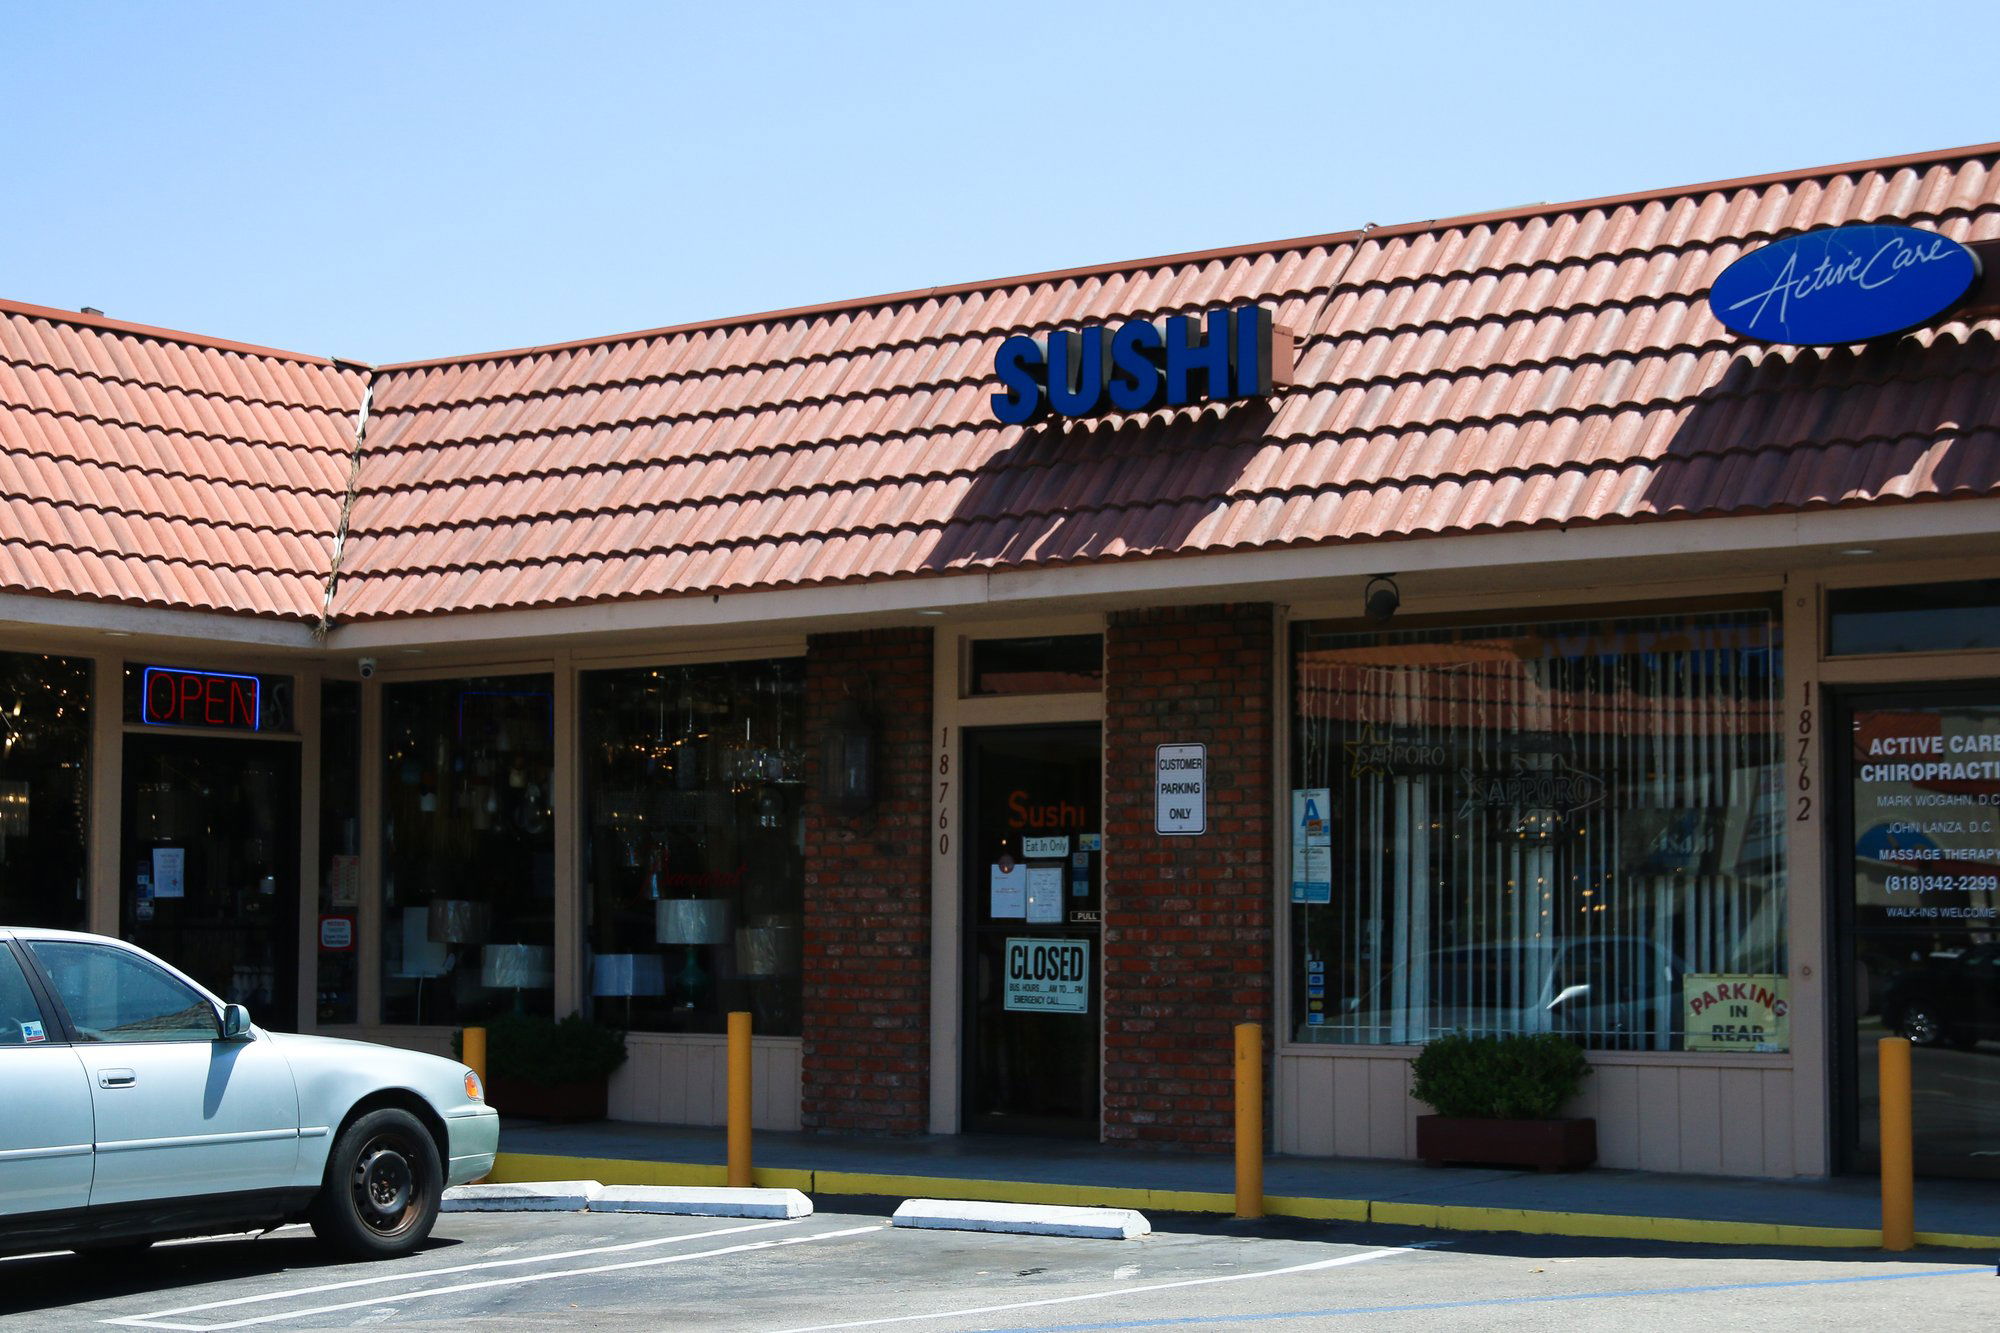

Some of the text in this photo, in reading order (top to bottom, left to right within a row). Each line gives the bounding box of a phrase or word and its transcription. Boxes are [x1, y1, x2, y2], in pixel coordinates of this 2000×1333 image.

[991, 304, 1260, 423] SUSHI
[148, 672, 256, 726] OPEN
[1359, 745, 1446, 766] SAPPORO
[1796, 680, 1812, 822] 18762
[1869, 736, 1945, 756] ACTIVE
[1159, 758, 1203, 770] CUSTOMER
[939, 726, 949, 855] 18760
[1160, 782, 1201, 794] PARKING
[1475, 778, 1593, 802] SAPPORO
[1008, 789, 1087, 829] Sushi
[1876, 795, 1912, 807] MARK
[1169, 808, 1192, 820] ONLY
[1300, 799, 1320, 827] A
[1886, 821, 1920, 834] JOHN
[1025, 840, 1038, 852] Eat
[1040, 840, 1048, 851] In
[1049, 840, 1067, 853] Only
[1879, 848, 1940, 861] MASSAGE
[1885, 875, 1997, 895] (818)342-2299
[1077, 912, 1097, 920] PULL
[1886, 906, 1997, 919] WALK-INS WELCOME
[1010, 945, 1084, 981] CLOSED
[1014, 995, 1045, 1005] EMERGENCY
[1690, 983, 1788, 1017] PARKING
[1730, 1005, 1748, 1018] IN
[1712, 1024, 1765, 1042] REAR
